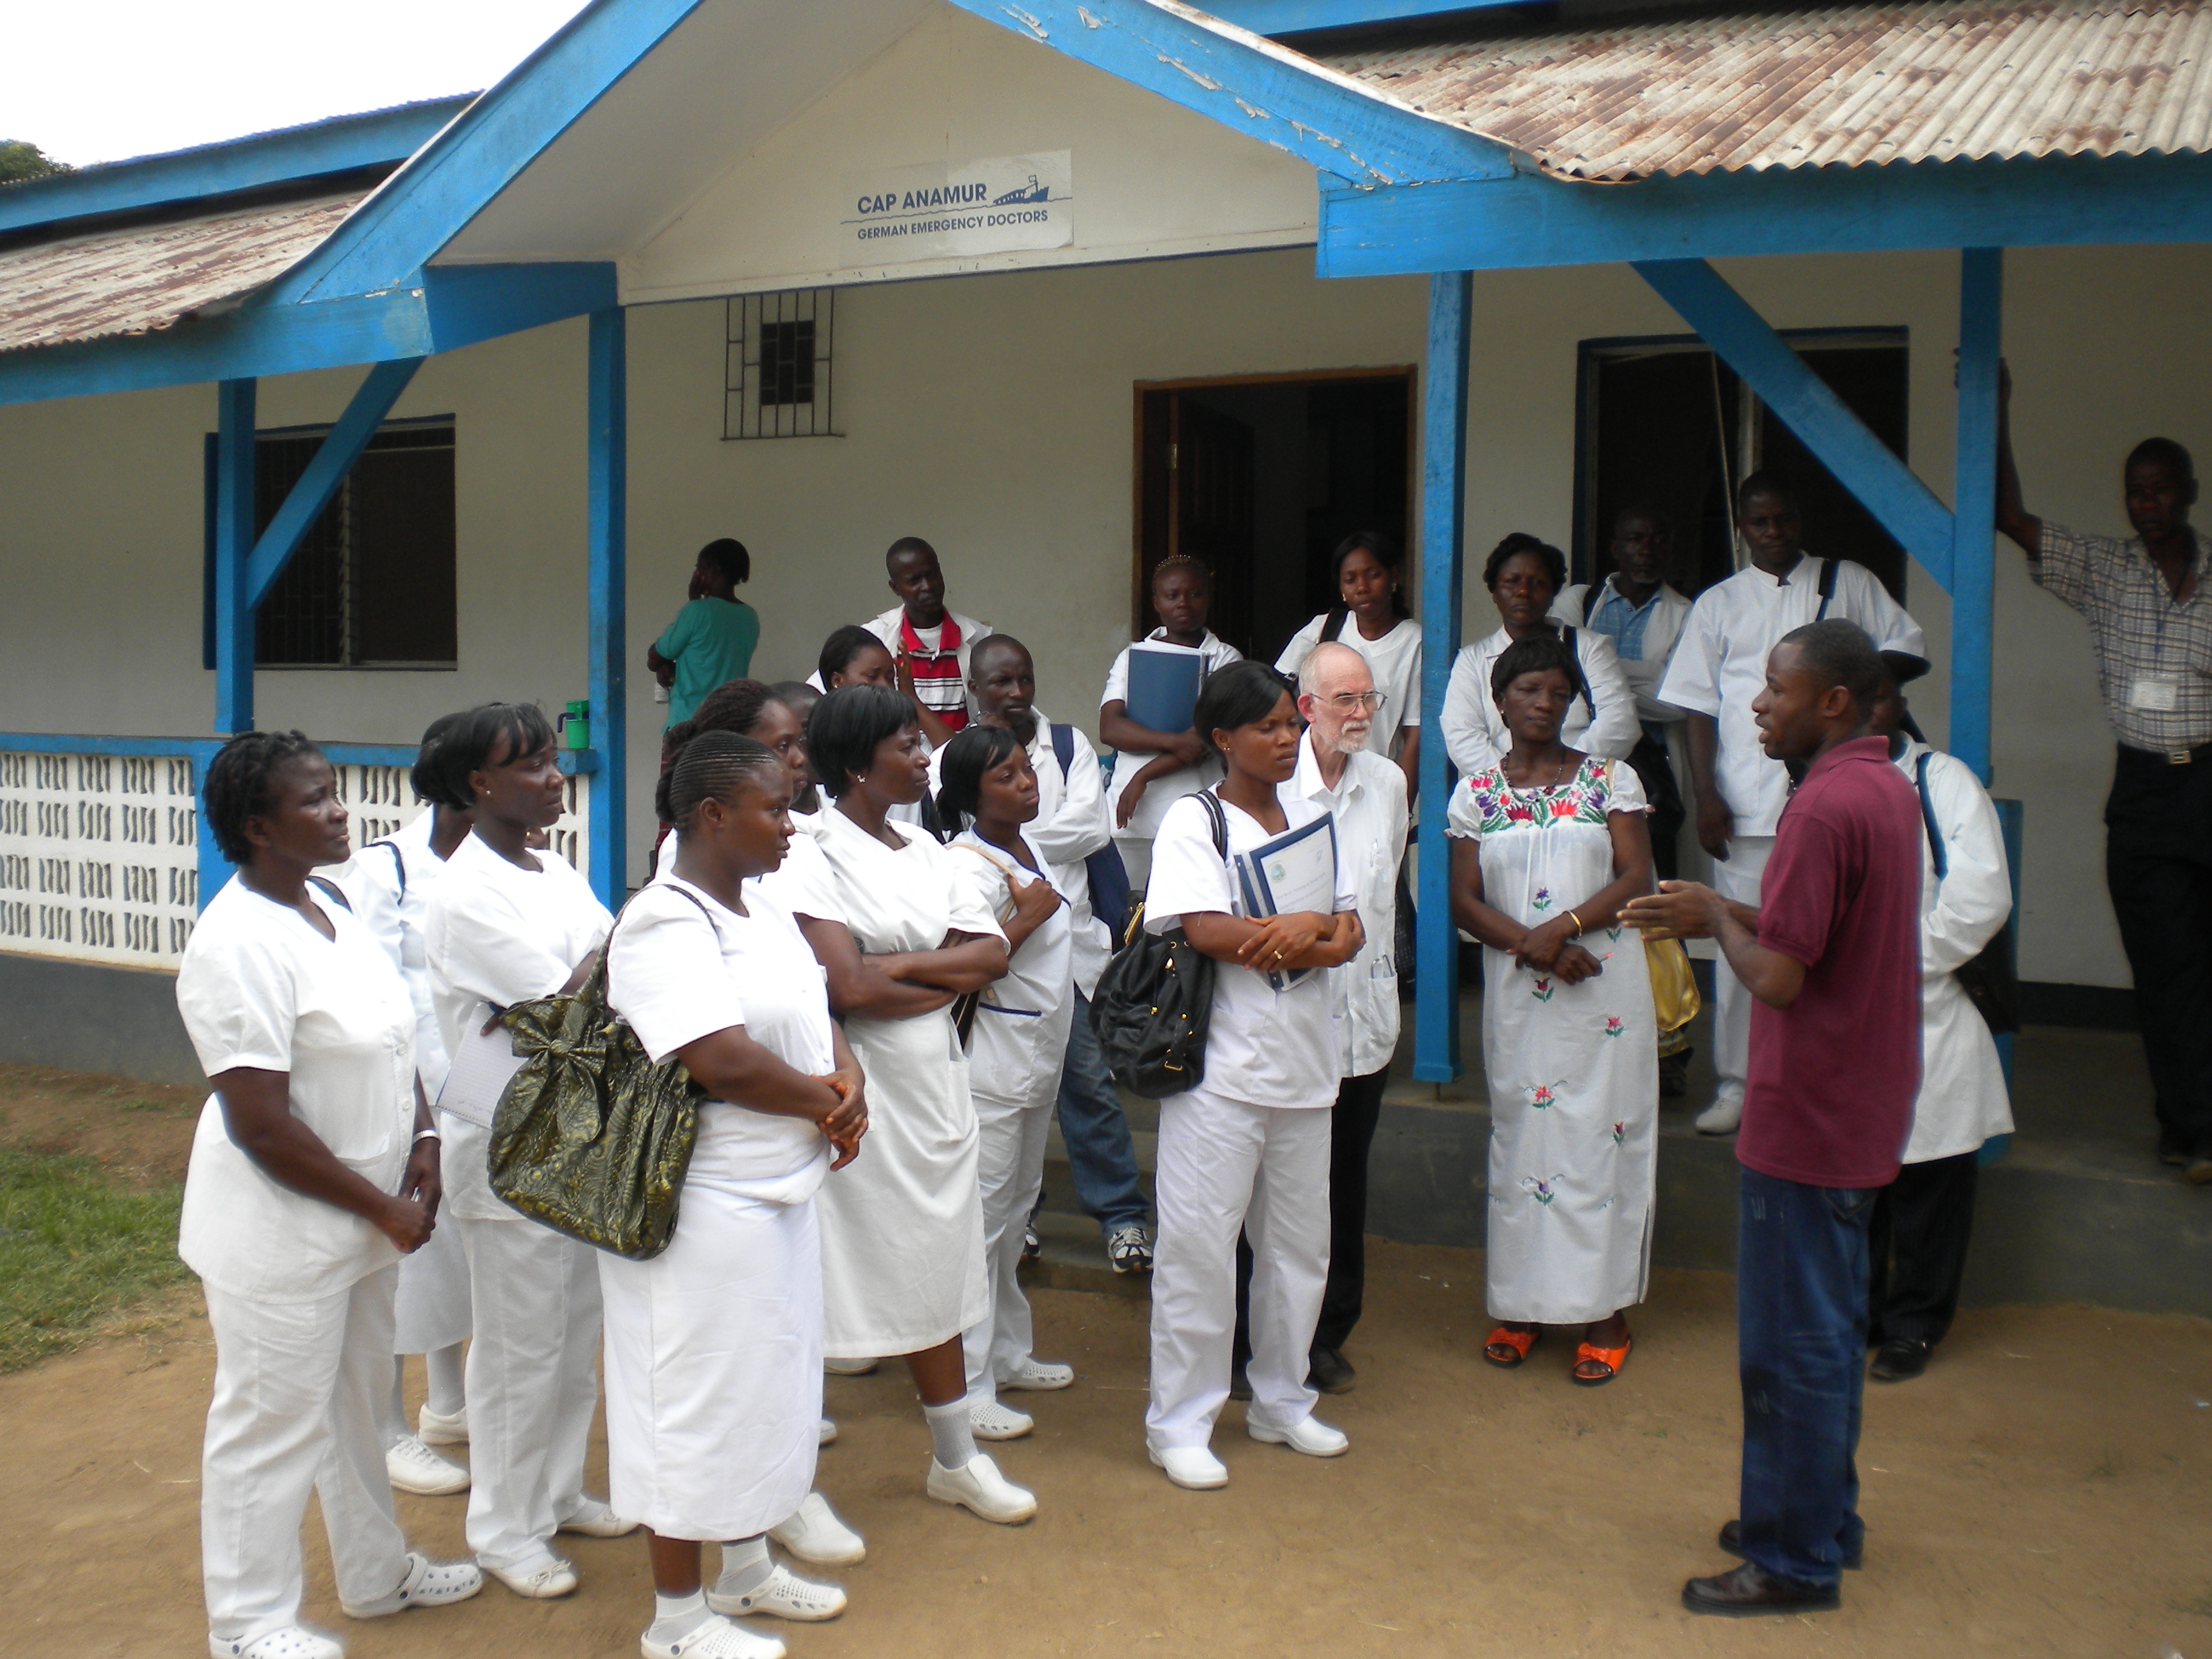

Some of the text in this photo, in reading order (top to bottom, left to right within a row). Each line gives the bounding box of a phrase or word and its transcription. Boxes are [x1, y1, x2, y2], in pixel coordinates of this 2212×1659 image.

[857, 183, 987, 214] CAP ANAMUR
[857, 210, 1048, 240] GERMAN EMERGENCY DOCTORS
